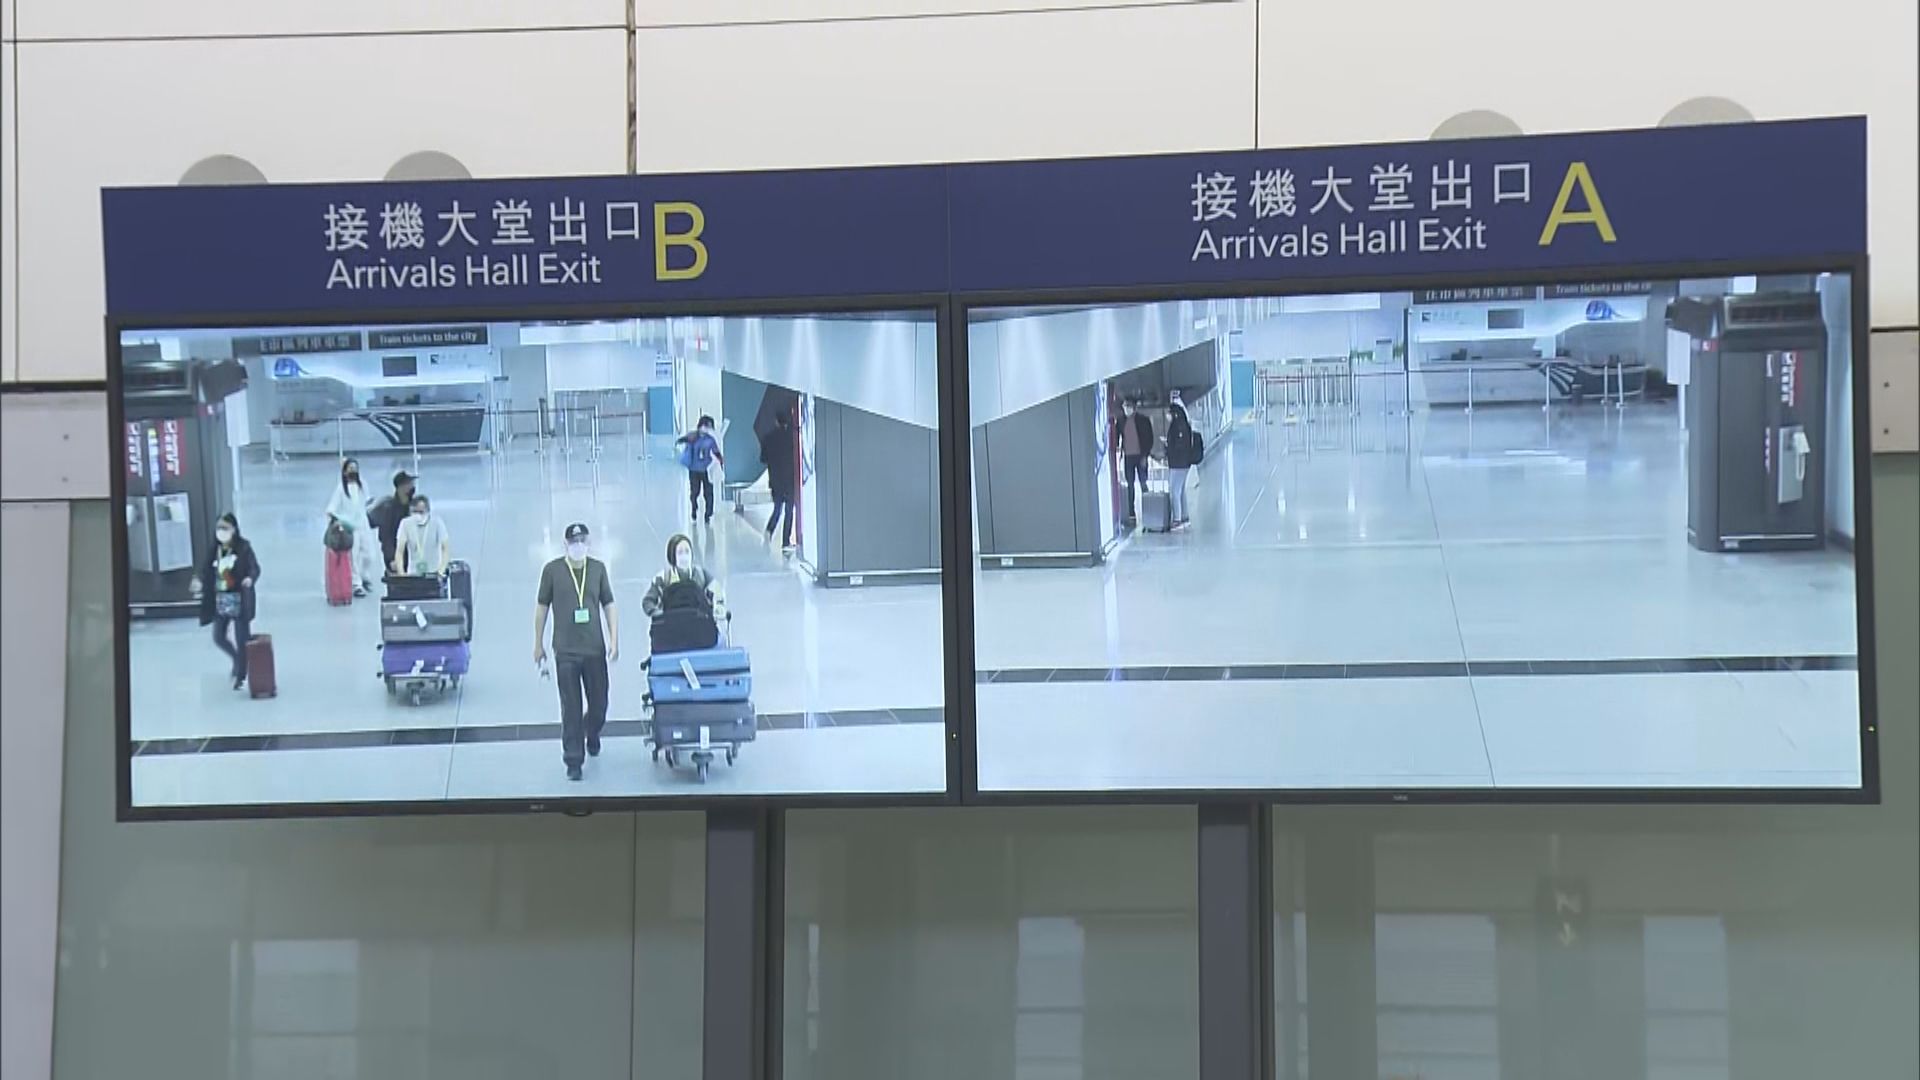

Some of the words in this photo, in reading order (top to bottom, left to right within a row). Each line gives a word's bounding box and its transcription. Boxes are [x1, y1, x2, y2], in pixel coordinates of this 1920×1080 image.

[1191, 159, 1531, 222] 接機大堂出口
[1538, 161, 1617, 246] A
[323, 196, 640, 252] 接機大堂出口
[654, 202, 709, 281] B
[1192, 224, 1328, 261] Arrivals
[1340, 220, 1406, 255] Hall
[1419, 217, 1487, 252] Exit
[327, 257, 456, 289] Arrivals
[466, 254, 528, 286] Hall
[539, 252, 601, 284] Exit
[380, 333, 401, 344] Train
[402, 331, 431, 343] tickets
[433, 332, 443, 342] to
[444, 330, 459, 341] the
[461, 330, 477, 342] city
